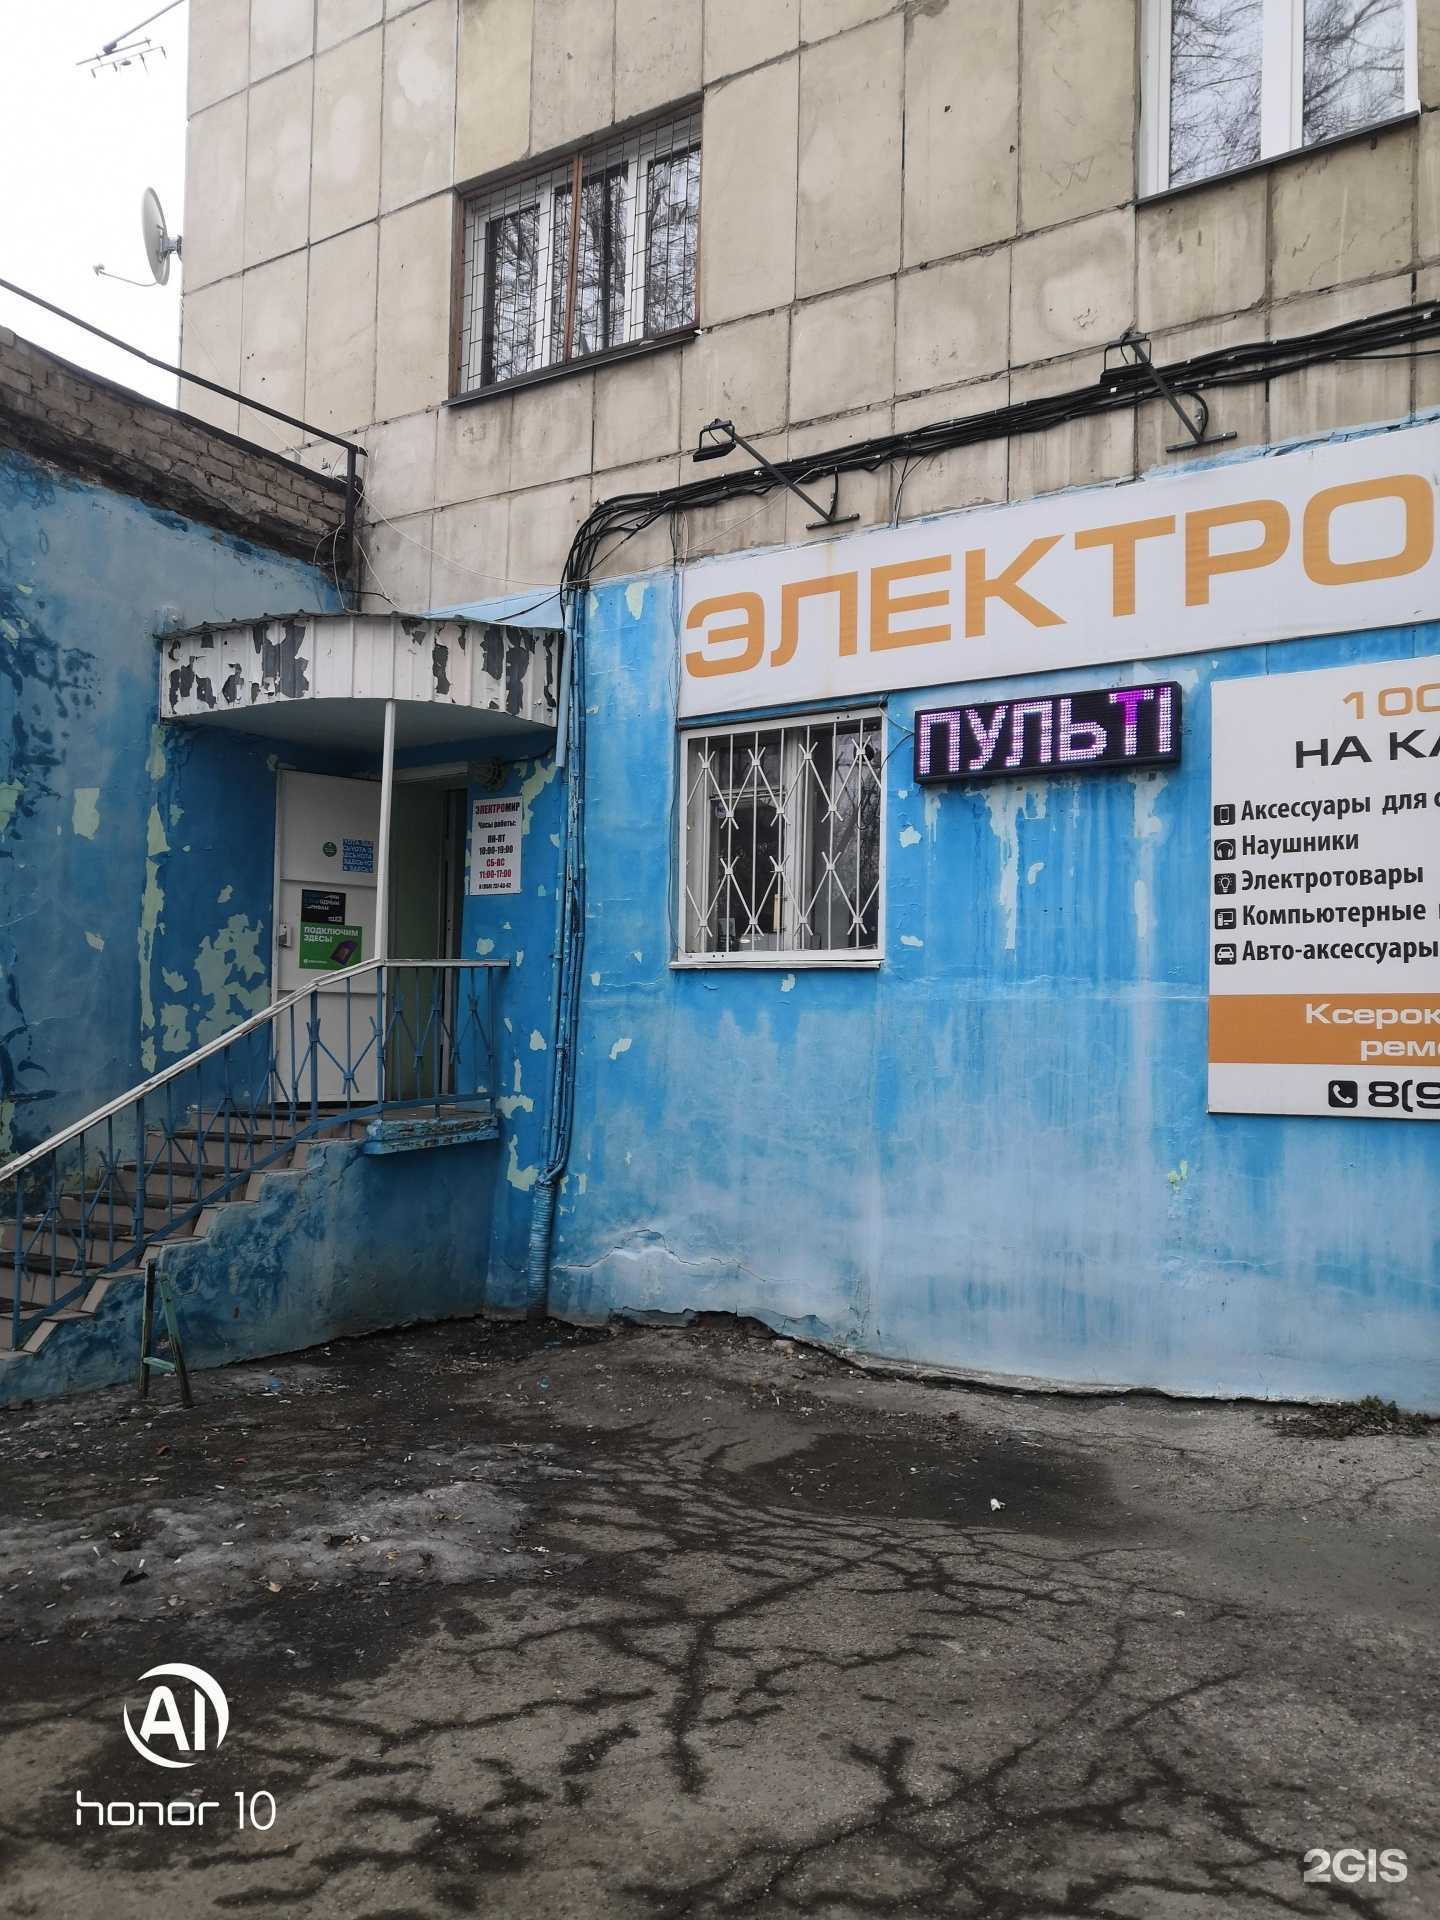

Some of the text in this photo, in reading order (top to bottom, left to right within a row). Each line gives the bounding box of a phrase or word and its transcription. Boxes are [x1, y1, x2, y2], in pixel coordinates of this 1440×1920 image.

[685, 473, 1436, 679] ЭЛЕКТРО
[1295, 728, 1440, 768] НА К
[475, 801, 521, 815] ЭЛЕКТРОМИР
[1241, 796, 1371, 822] Аксессуары
[1382, 792, 1428, 815] для
[479, 845, 514, 855] 10:00-19:00
[1242, 834, 1359, 860] Наушники
[479, 869, 512, 879] 11:00-17:00
[1241, 866, 1424, 893] Электротовары
[1242, 903, 1427, 927] Компьютерные
[304, 926, 359, 937] ПОДКЛЮЧИМ
[1242, 939, 1439, 964] Авто-аксессуары
[1360, 1040, 1440, 1061] рем
